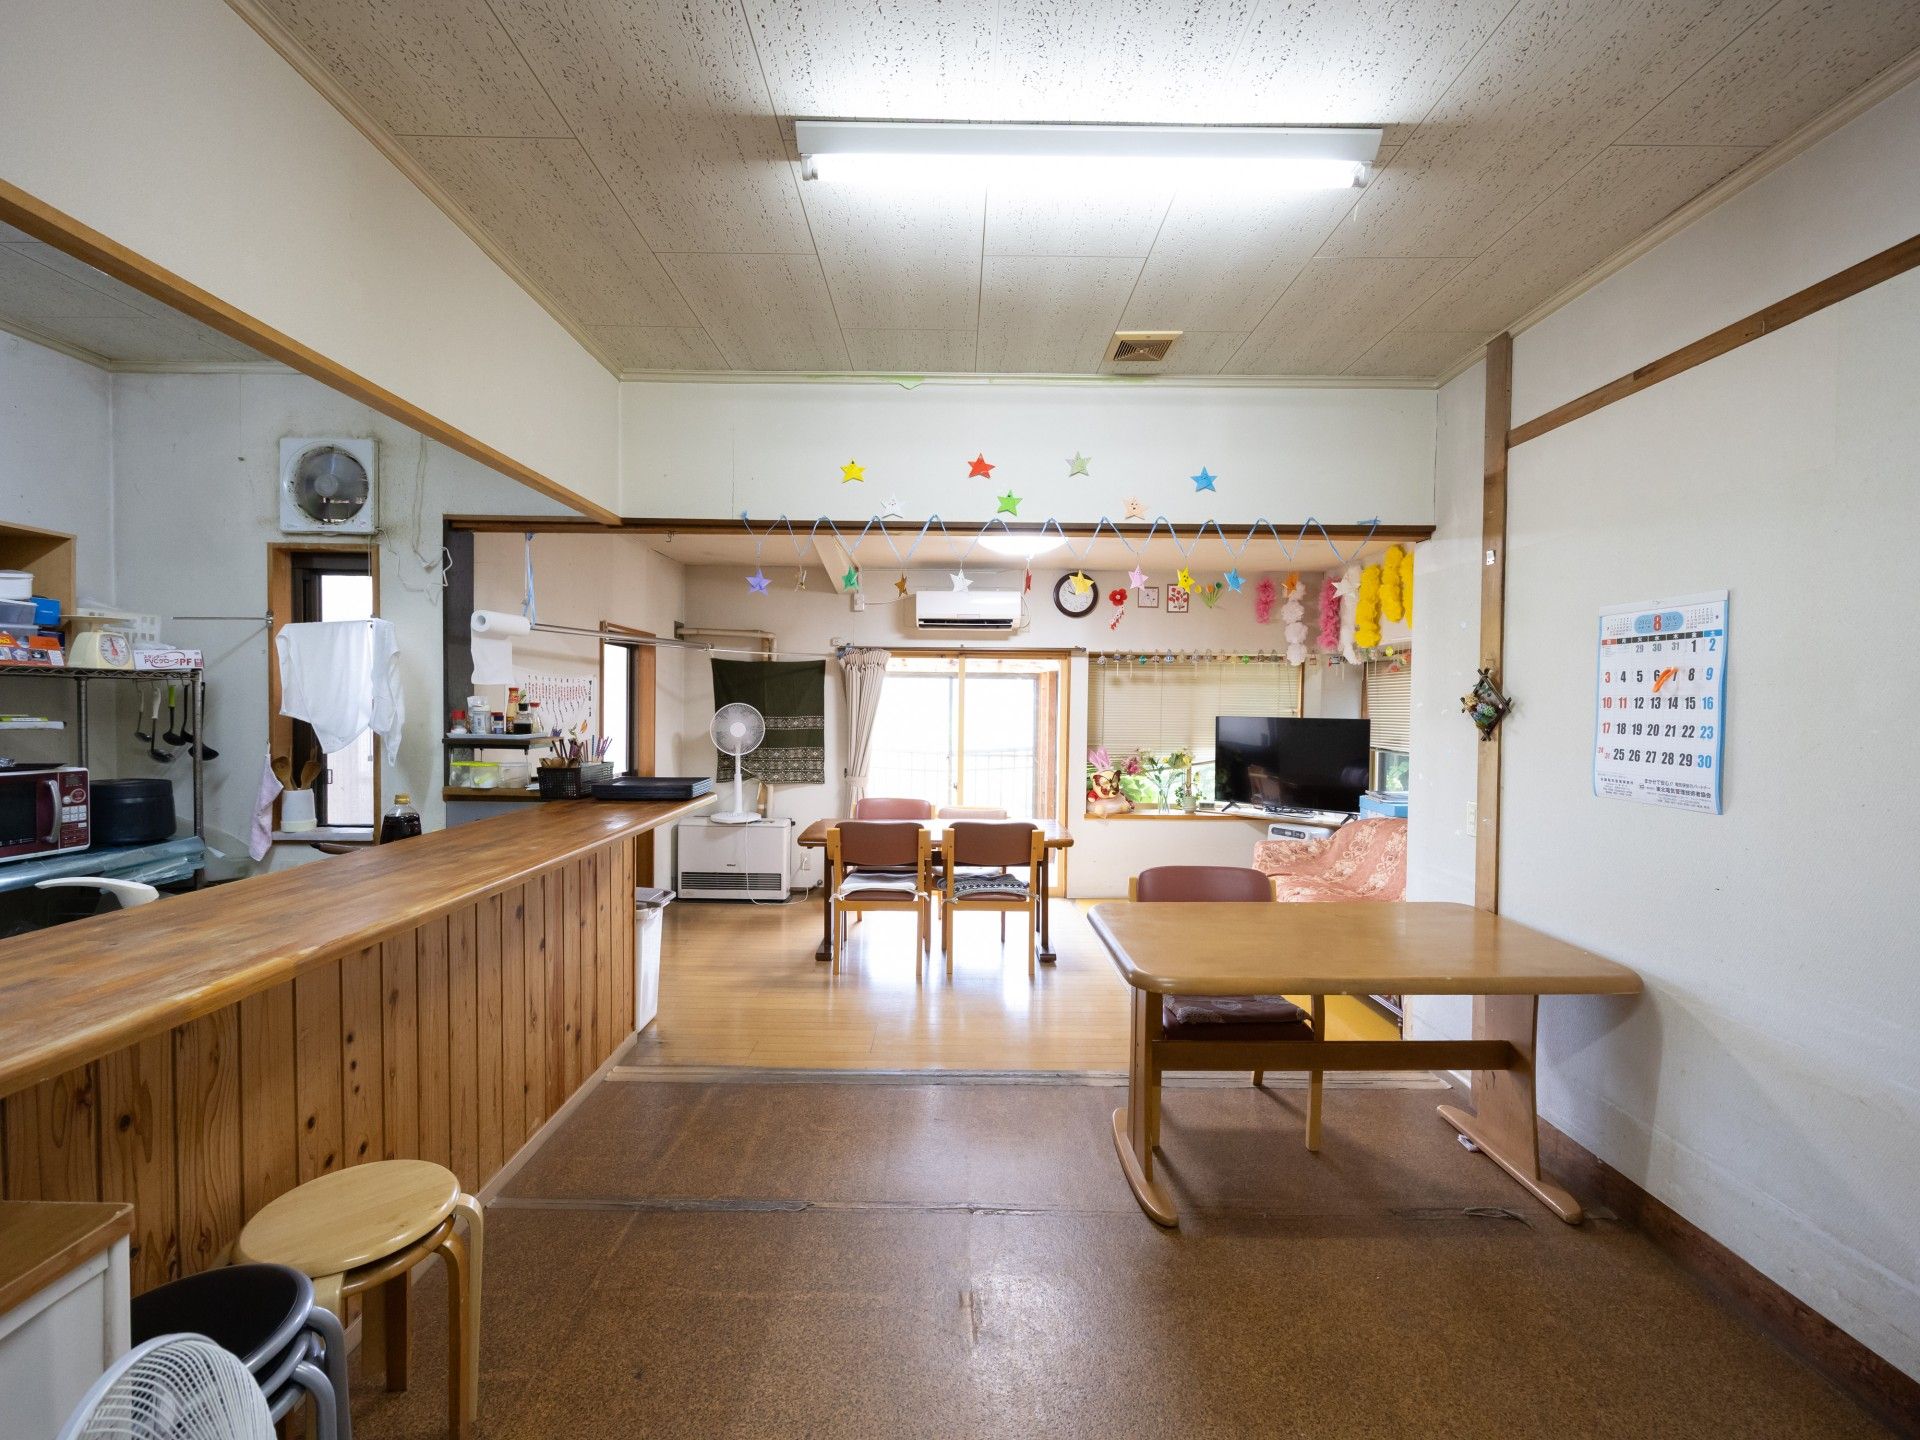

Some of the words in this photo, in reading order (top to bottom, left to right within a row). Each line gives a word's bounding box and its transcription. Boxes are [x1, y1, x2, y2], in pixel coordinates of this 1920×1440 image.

[1653, 614, 1662, 631] 8
[1635, 644, 1644, 653] 29
[1652, 643, 1662, 652] 30
[1671, 641, 1680, 651] 31
[1691, 640, 1697, 653] 1
[1709, 638, 1717, 651] 2
[179, 658, 192, 666] PF
[1605, 672, 1611, 683] 3
[1621, 671, 1627, 682] 4
[1637, 671, 1644, 682] 5
[1688, 668, 1696, 681] 8
[1706, 668, 1714, 680] 9
[1603, 697, 1613, 708] 10
[1619, 697, 1628, 708] 11
[1634, 697, 1645, 709] 12
[1650, 697, 1662, 709] 13
[1668, 697, 1679, 709] 14
[1685, 697, 1696, 709] 15
[1702, 697, 1714, 709] 16
[1603, 723, 1611, 733] 17
[1617, 723, 1627, 734] 18
[1632, 724, 1643, 735] 19
[1647, 724, 1660, 736] 20
[1665, 725, 1677, 737] 21
[1682, 725, 1696, 738] 22
[1700, 726, 1714, 739] 23
[1614, 749, 1625, 760] 25
[1629, 750, 1641, 762] 26
[1646, 751, 1657, 763] 27
[1662, 752, 1675, 765] 28
[1679, 753, 1693, 766] 29
[1698, 755, 1713, 768] 30
